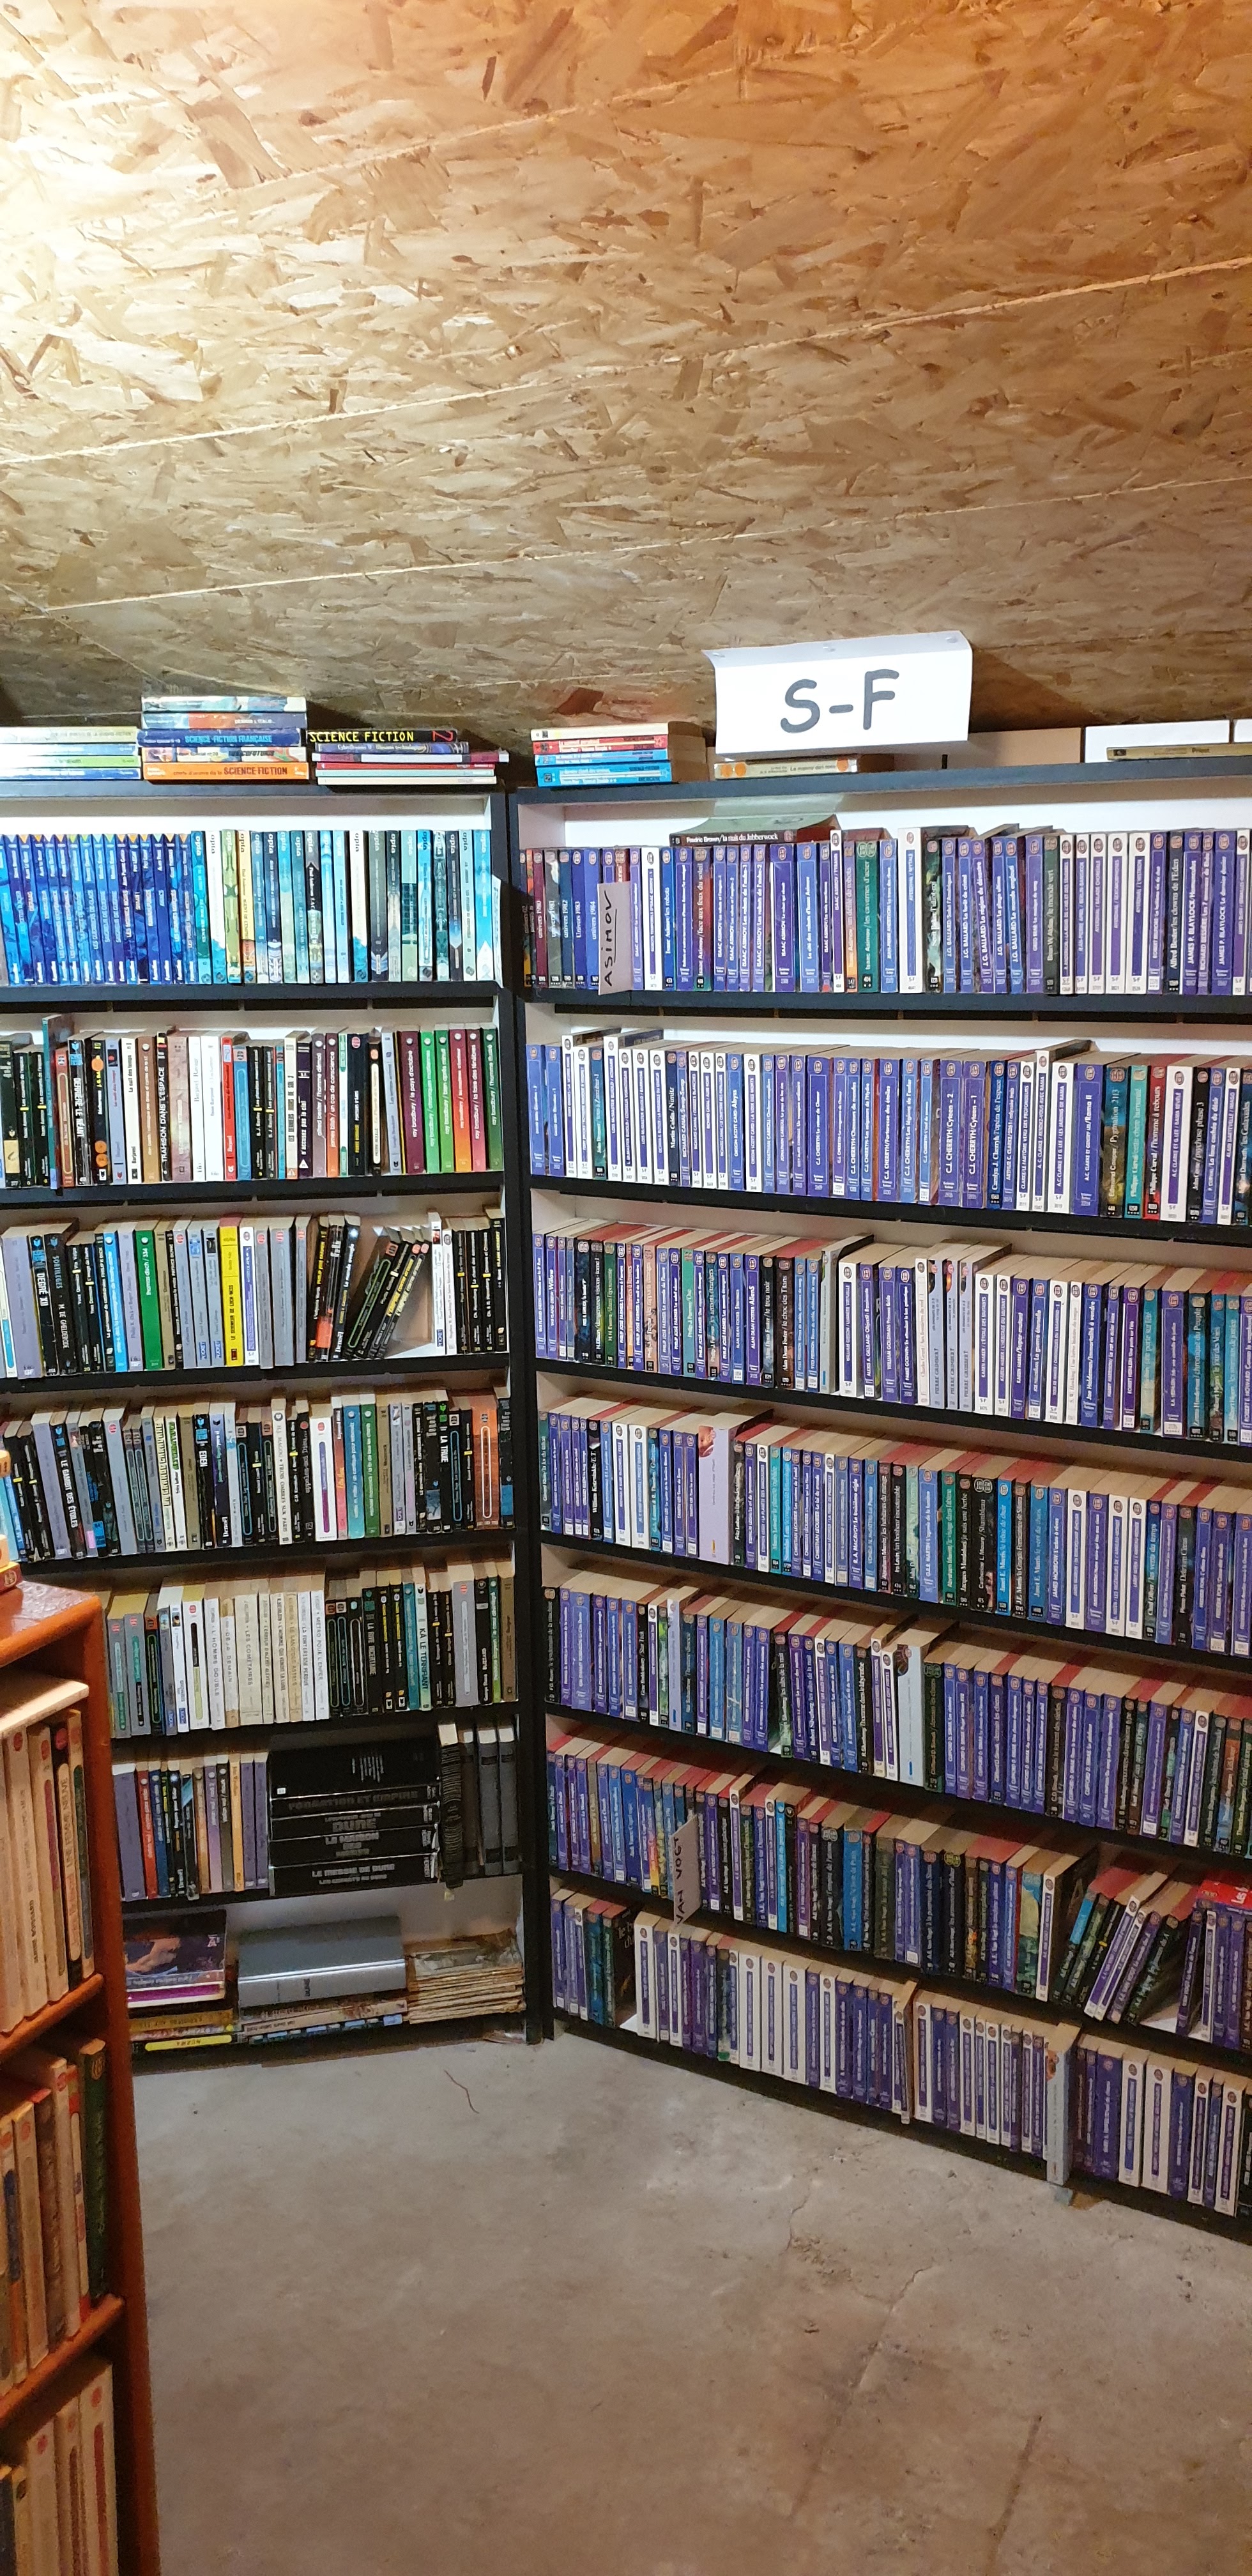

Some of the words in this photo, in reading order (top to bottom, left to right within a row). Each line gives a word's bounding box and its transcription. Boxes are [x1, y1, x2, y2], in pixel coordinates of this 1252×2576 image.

[780, 668, 900, 734] S-F
[310, 731, 359, 742] SCIENCE
[365, 731, 413, 742] FICTION
[199, 1451, 208, 1467] EDEN
[674, 1836, 682, 1879] VOGT
[675, 1890, 685, 1924] VAN
